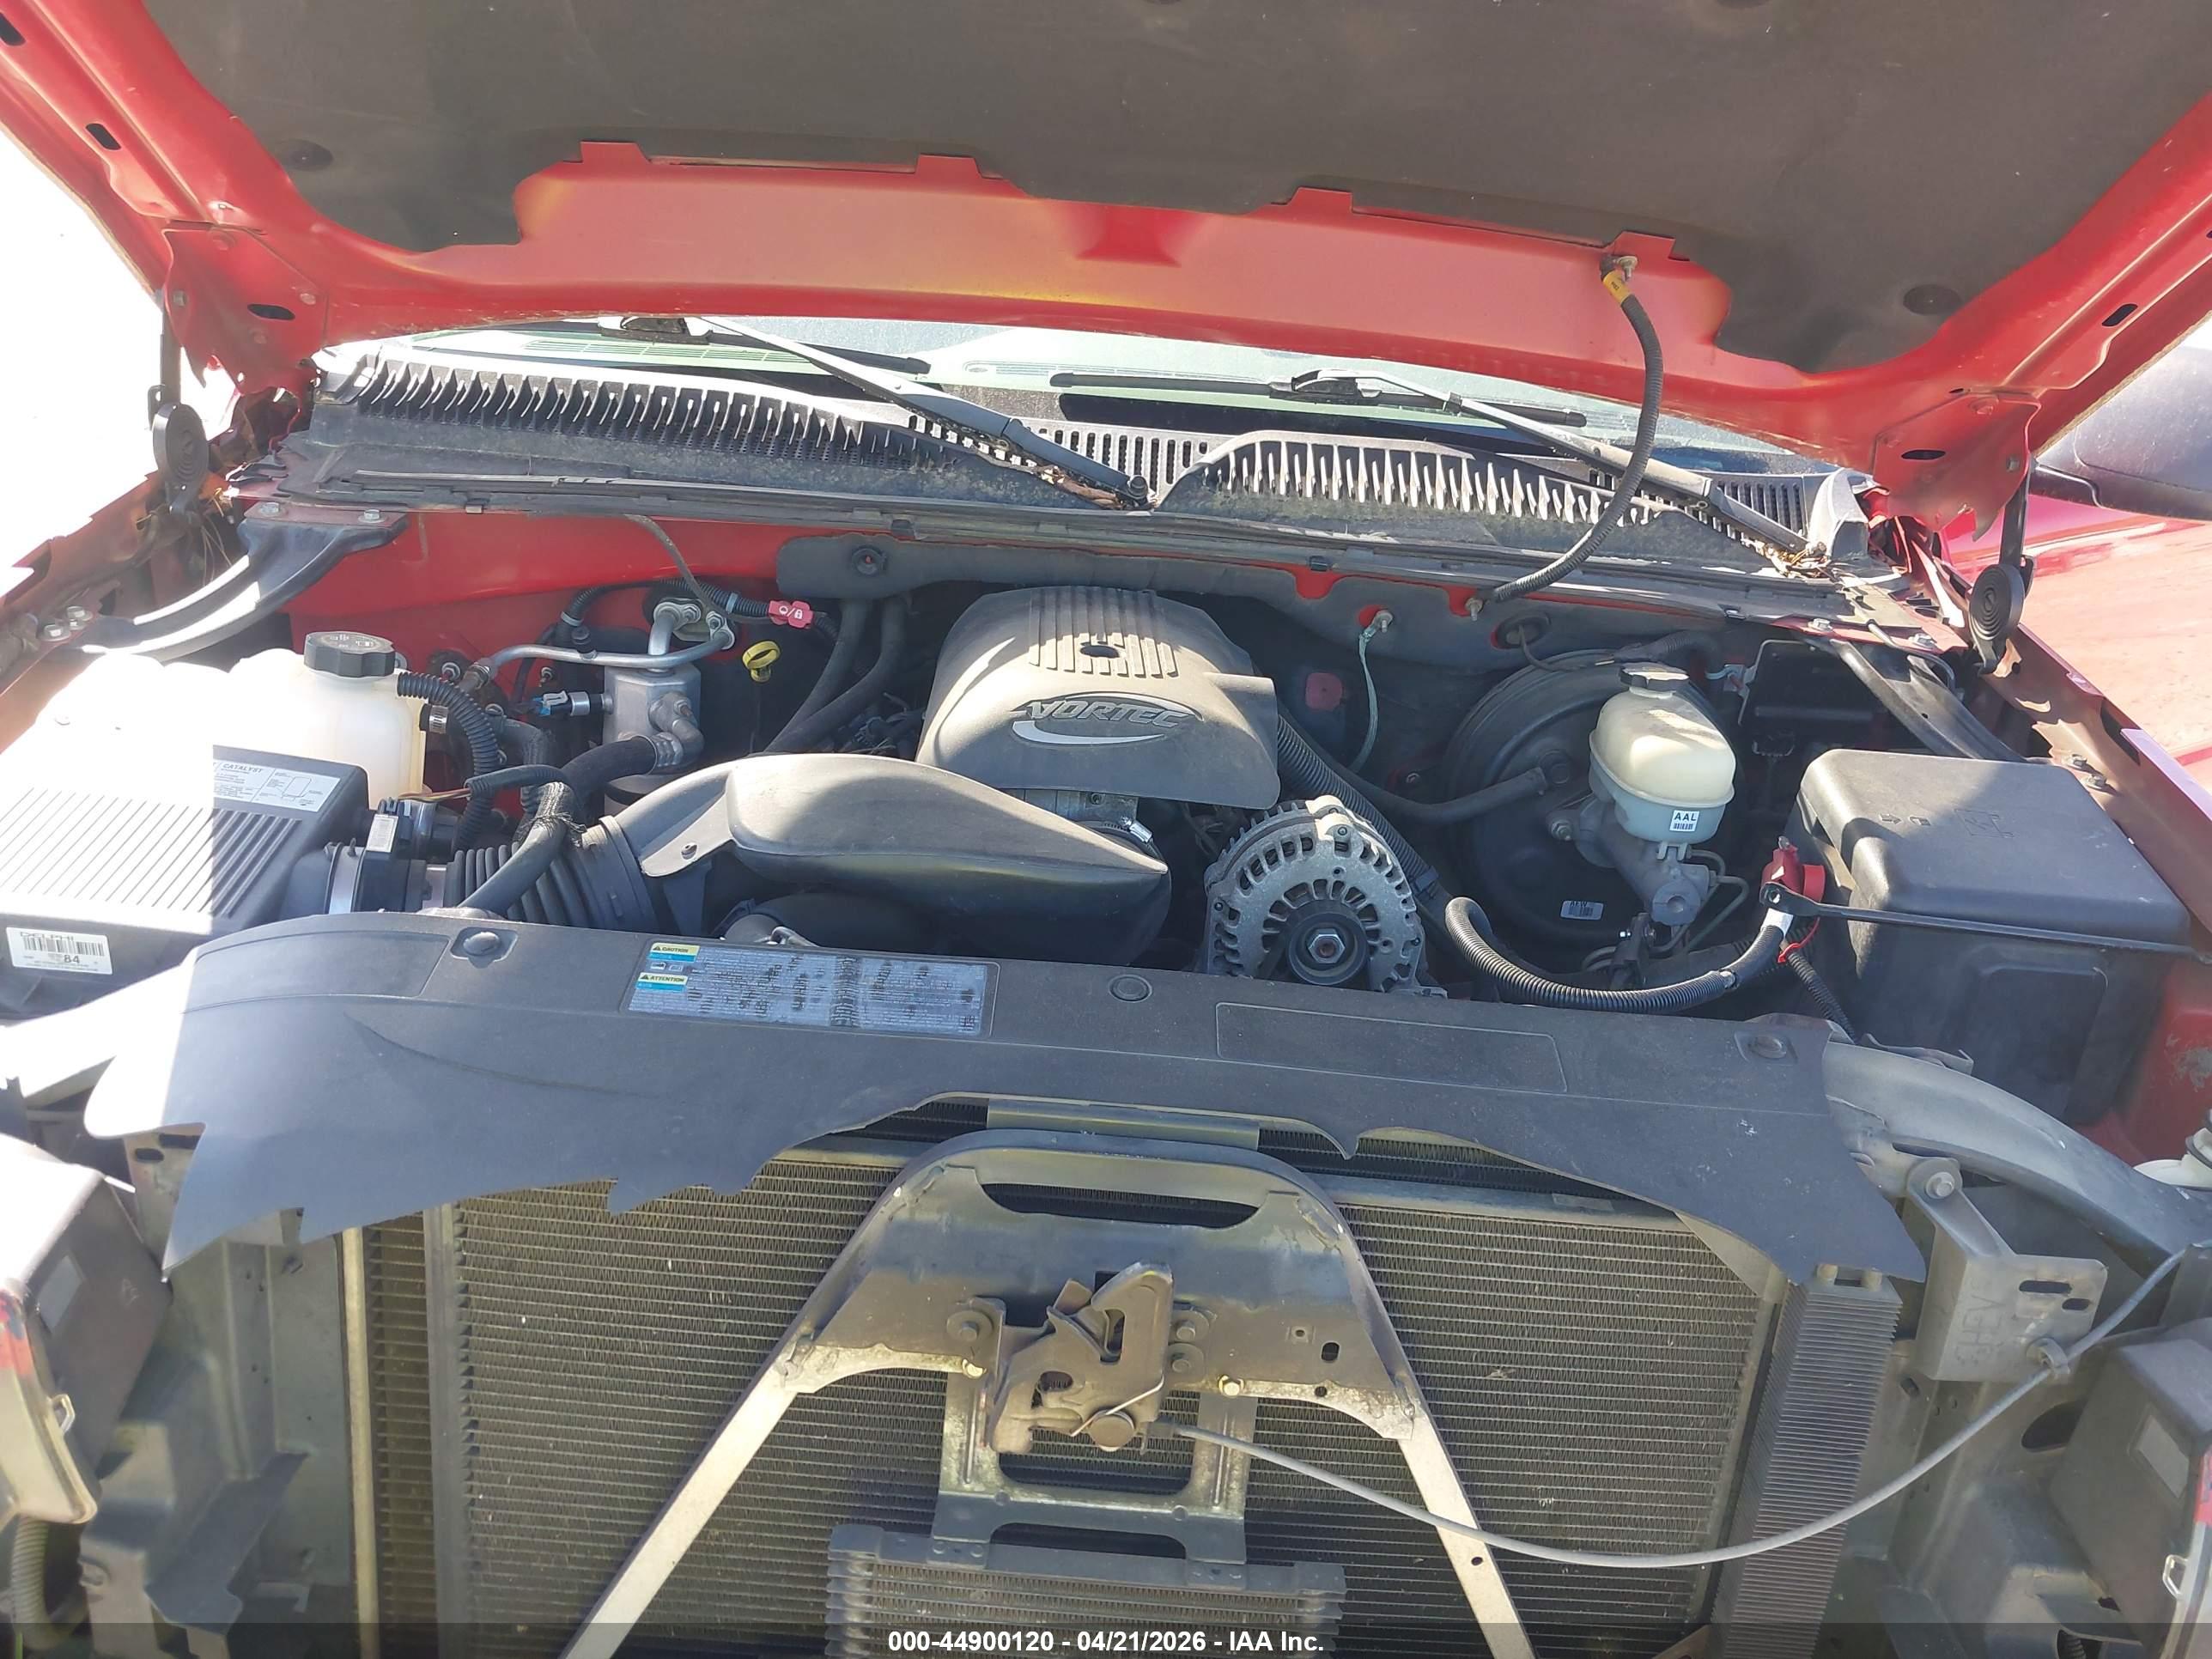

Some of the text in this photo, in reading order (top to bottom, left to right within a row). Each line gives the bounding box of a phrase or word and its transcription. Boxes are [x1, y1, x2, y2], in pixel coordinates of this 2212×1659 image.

[1026, 699, 1189, 727] VORTEC
[222, 763, 263, 774] CATALYST
[1674, 812, 1697, 821] AAL
[64, 954, 81, 963] 84
